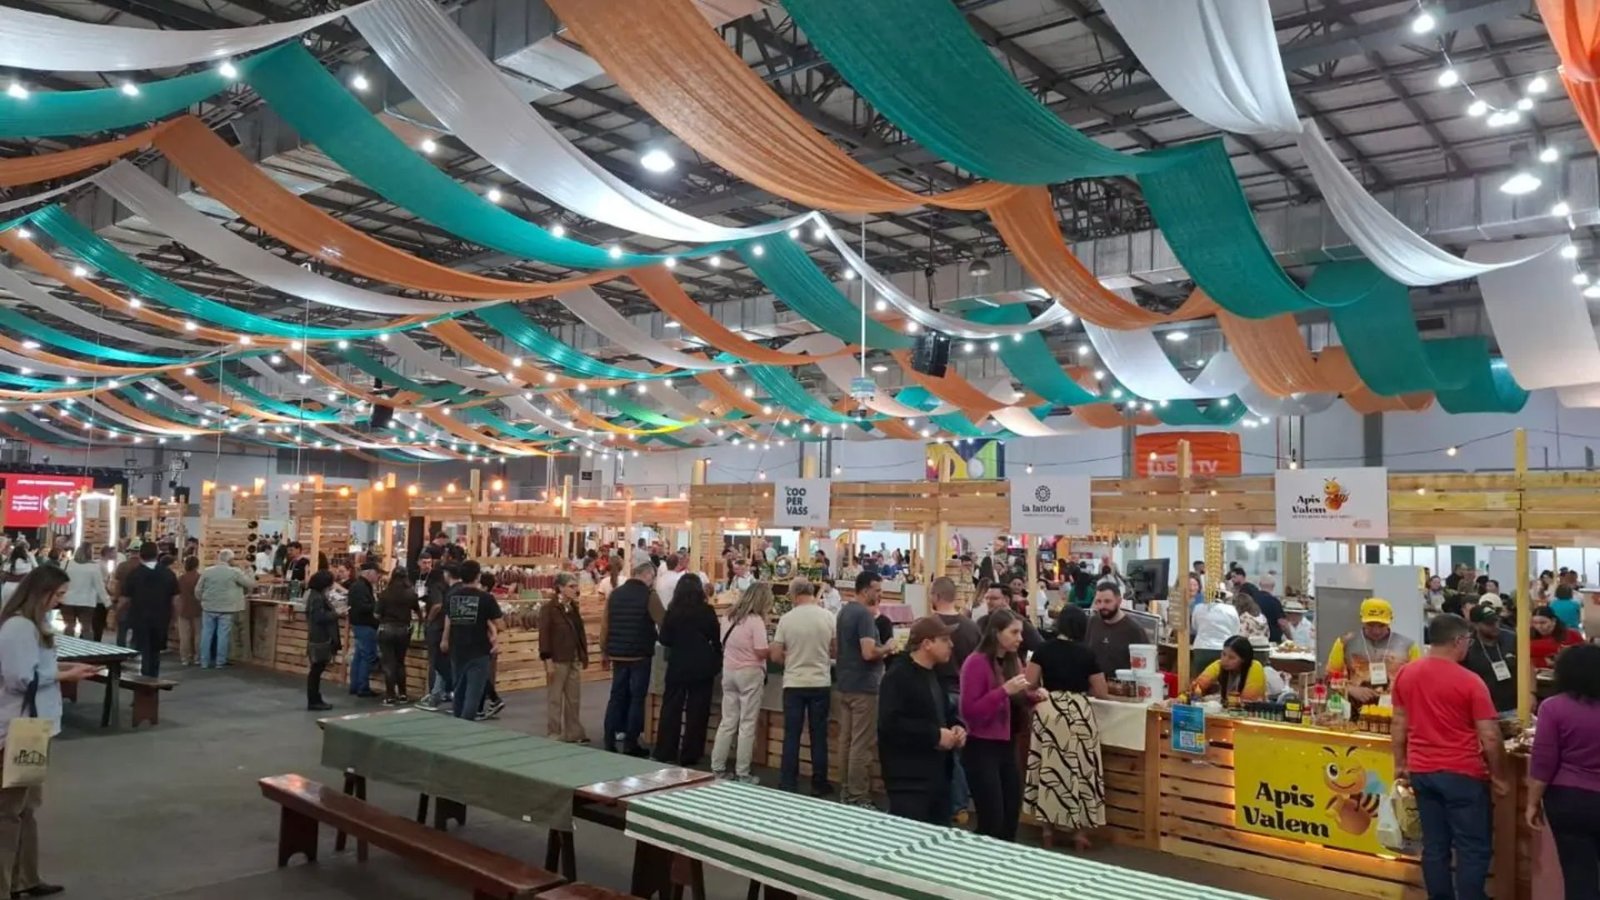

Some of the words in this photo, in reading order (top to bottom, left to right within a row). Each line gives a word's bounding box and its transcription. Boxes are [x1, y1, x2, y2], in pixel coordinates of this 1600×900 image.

[786, 487, 806, 496] COO
[786, 496, 803, 506] PER
[1297, 494, 1321, 505] Apis
[786, 506, 808, 516] VASS
[1022, 504, 1030, 512] la
[1292, 506, 1327, 514] Valem
[1256, 781, 1315, 809] Apis
[1242, 805, 1330, 838] Valem
